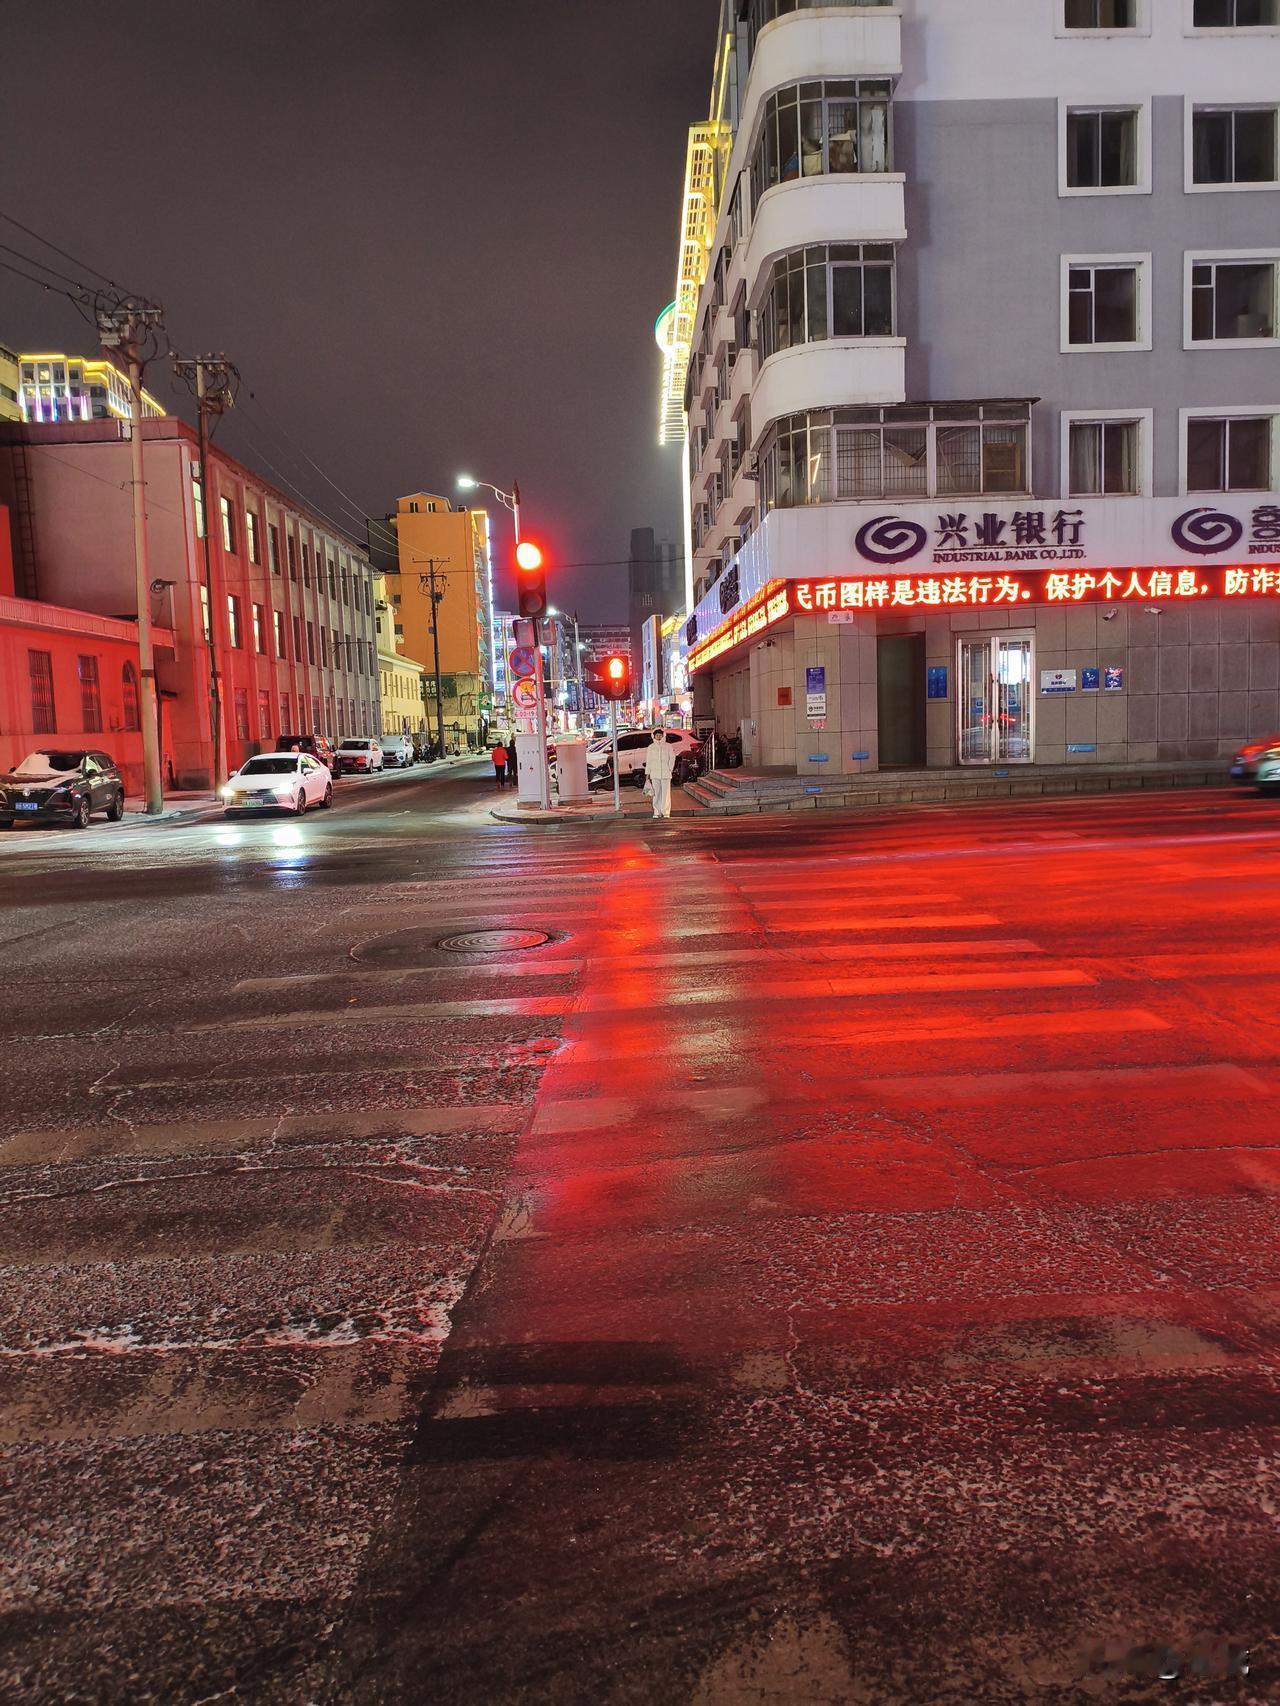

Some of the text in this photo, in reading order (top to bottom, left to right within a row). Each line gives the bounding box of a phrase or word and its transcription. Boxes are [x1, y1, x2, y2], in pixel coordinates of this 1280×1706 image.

[934, 510, 1085, 546] 兴业银行
[932, 551, 1003, 562] INDUSTRIAL
[1004, 550, 1038, 561] BANK
